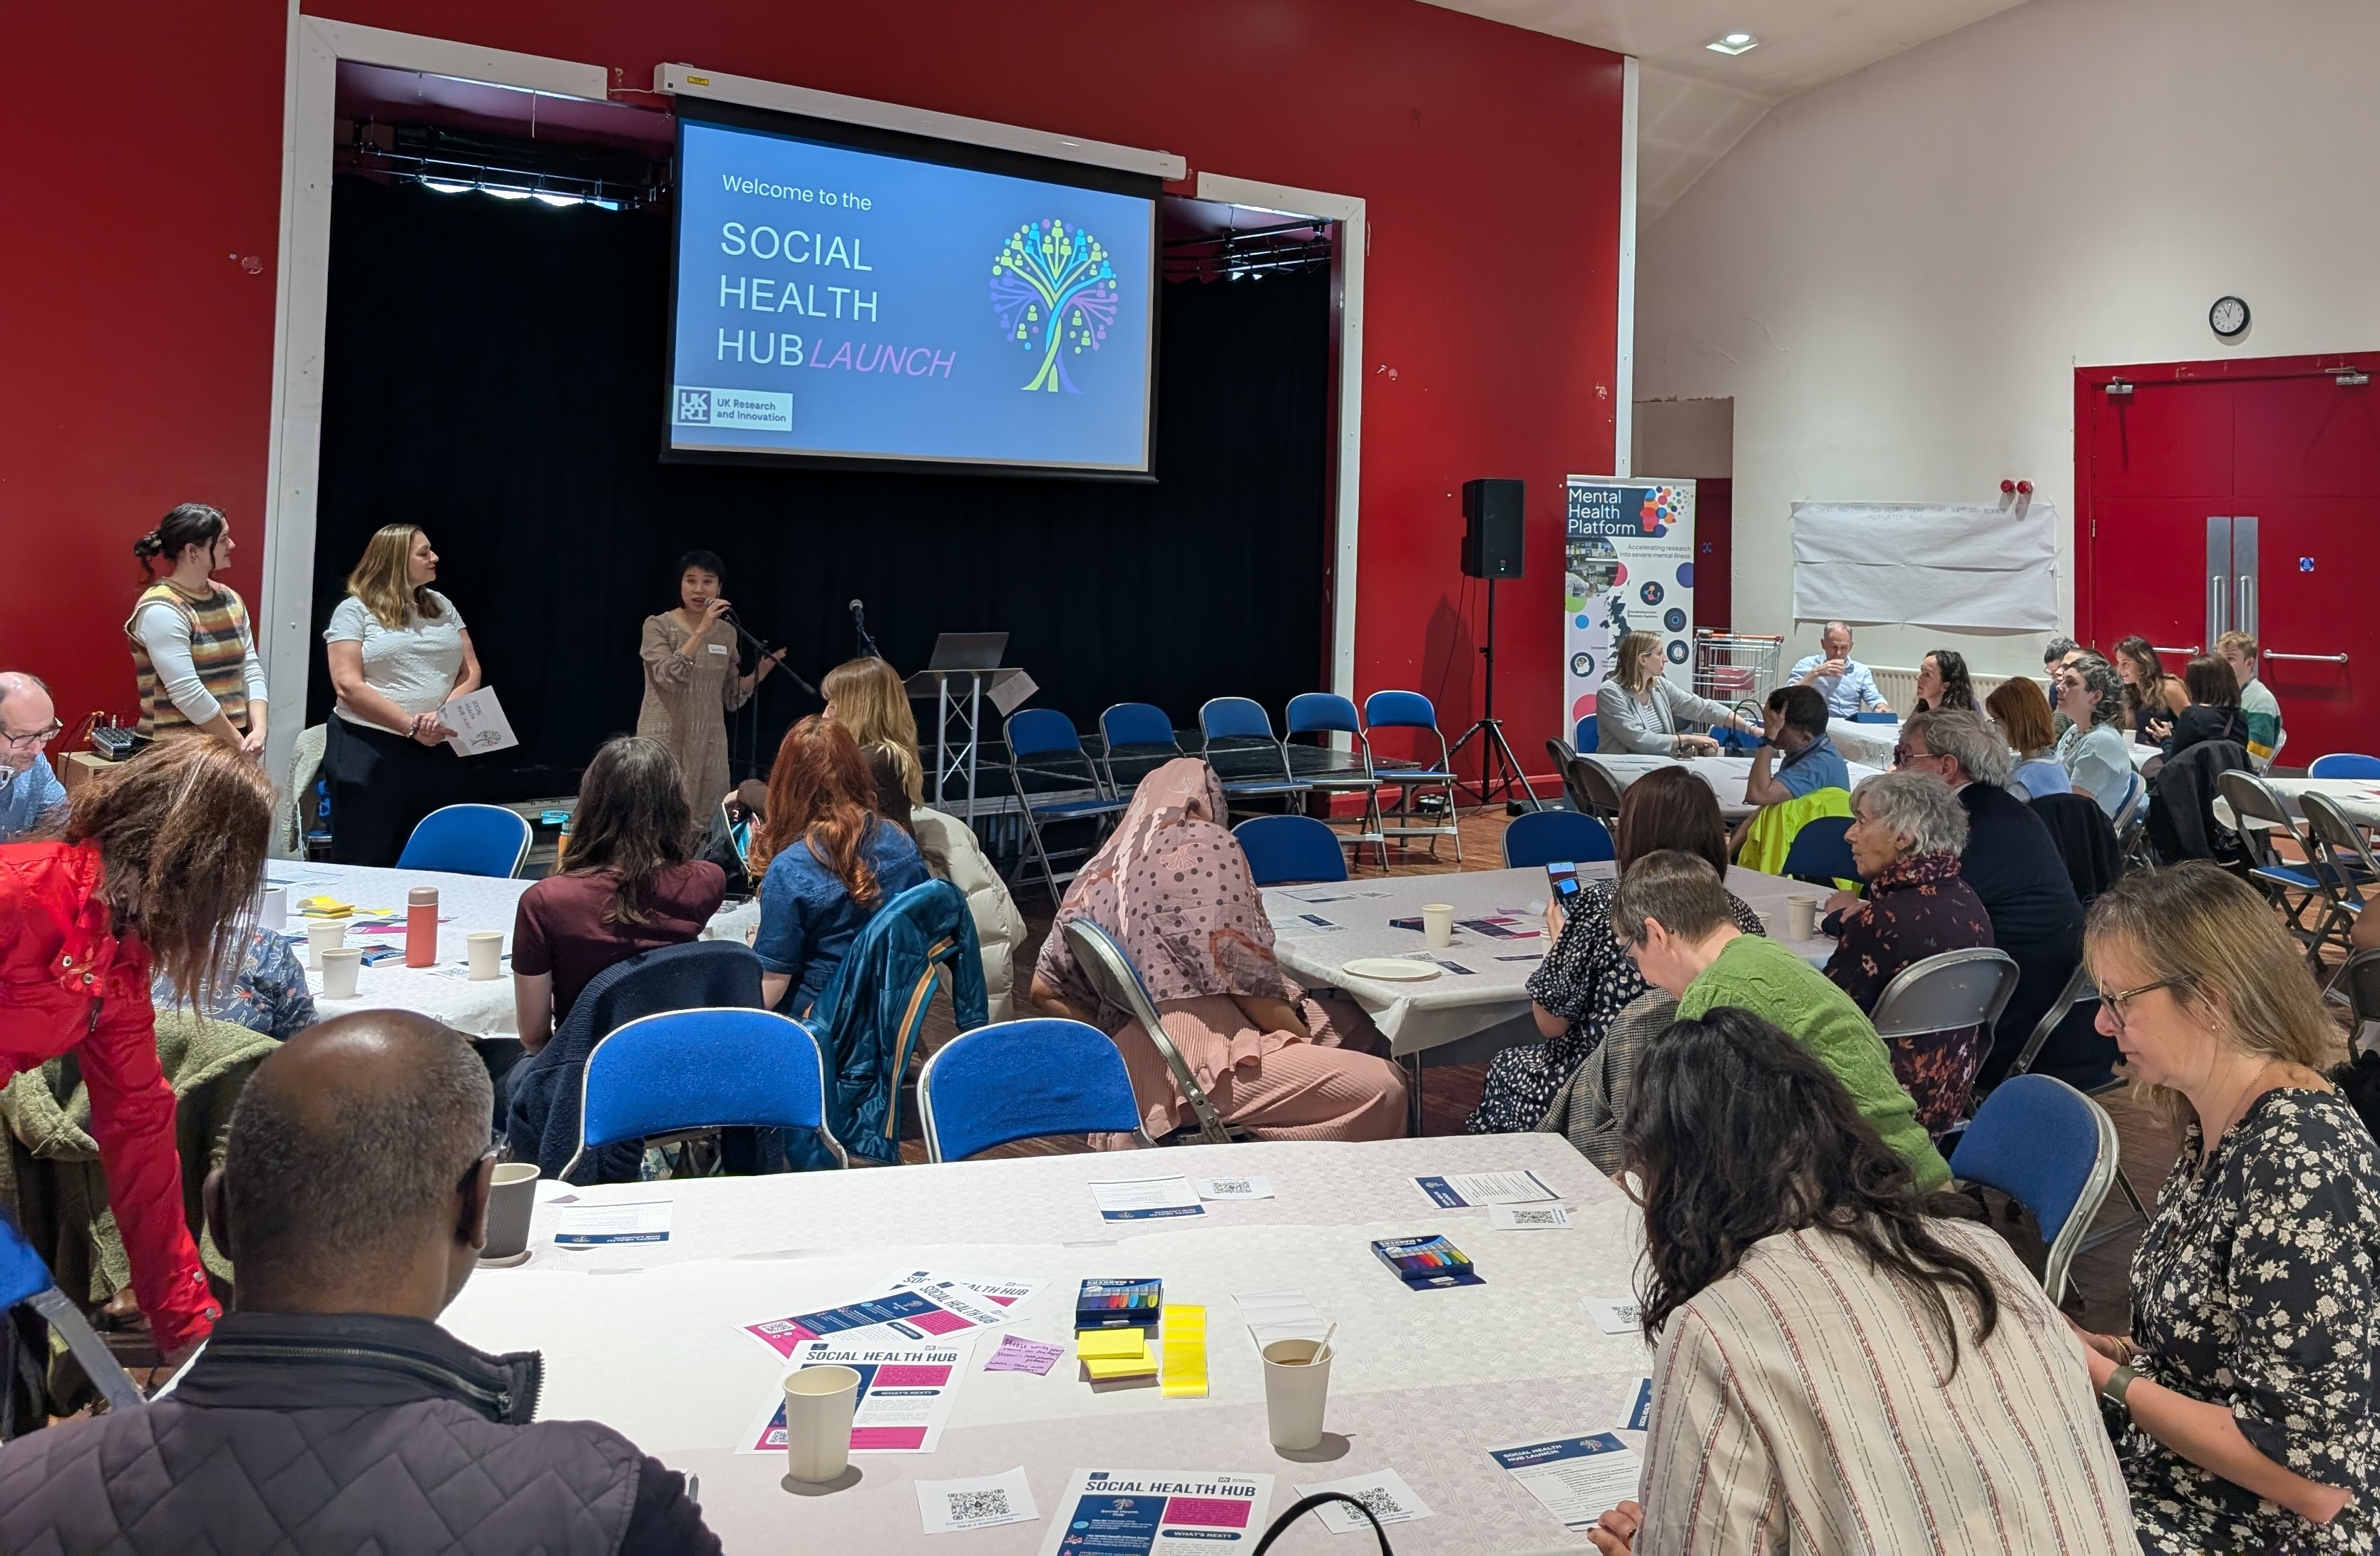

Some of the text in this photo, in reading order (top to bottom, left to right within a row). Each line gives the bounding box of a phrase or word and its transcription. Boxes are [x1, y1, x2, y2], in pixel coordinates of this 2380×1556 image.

[722, 175, 872, 211] Welcome to the
[721, 222, 873, 271] SOCIAL
[719, 274, 878, 322] HEALTH
[717, 328, 957, 378] HUB LAUNCH
[717, 398, 776, 411] UK Research
[717, 411, 786, 422] and Innovation
[1569, 488, 1622, 504] Mental
[1569, 504, 1620, 520] Health
[1569, 519, 1636, 535] Platform
[919, 1285, 947, 1304] SOCIAL
[944, 1299, 981, 1319] HEALTH
[1005, 1338, 1027, 1349] Please
[806, 1351, 958, 1362] SOCIAL HEALTH HUB
[1532, 1444, 1563, 1453] HEALTH
[1085, 1481, 1256, 1497] SOCIAL HEALTH HUB
